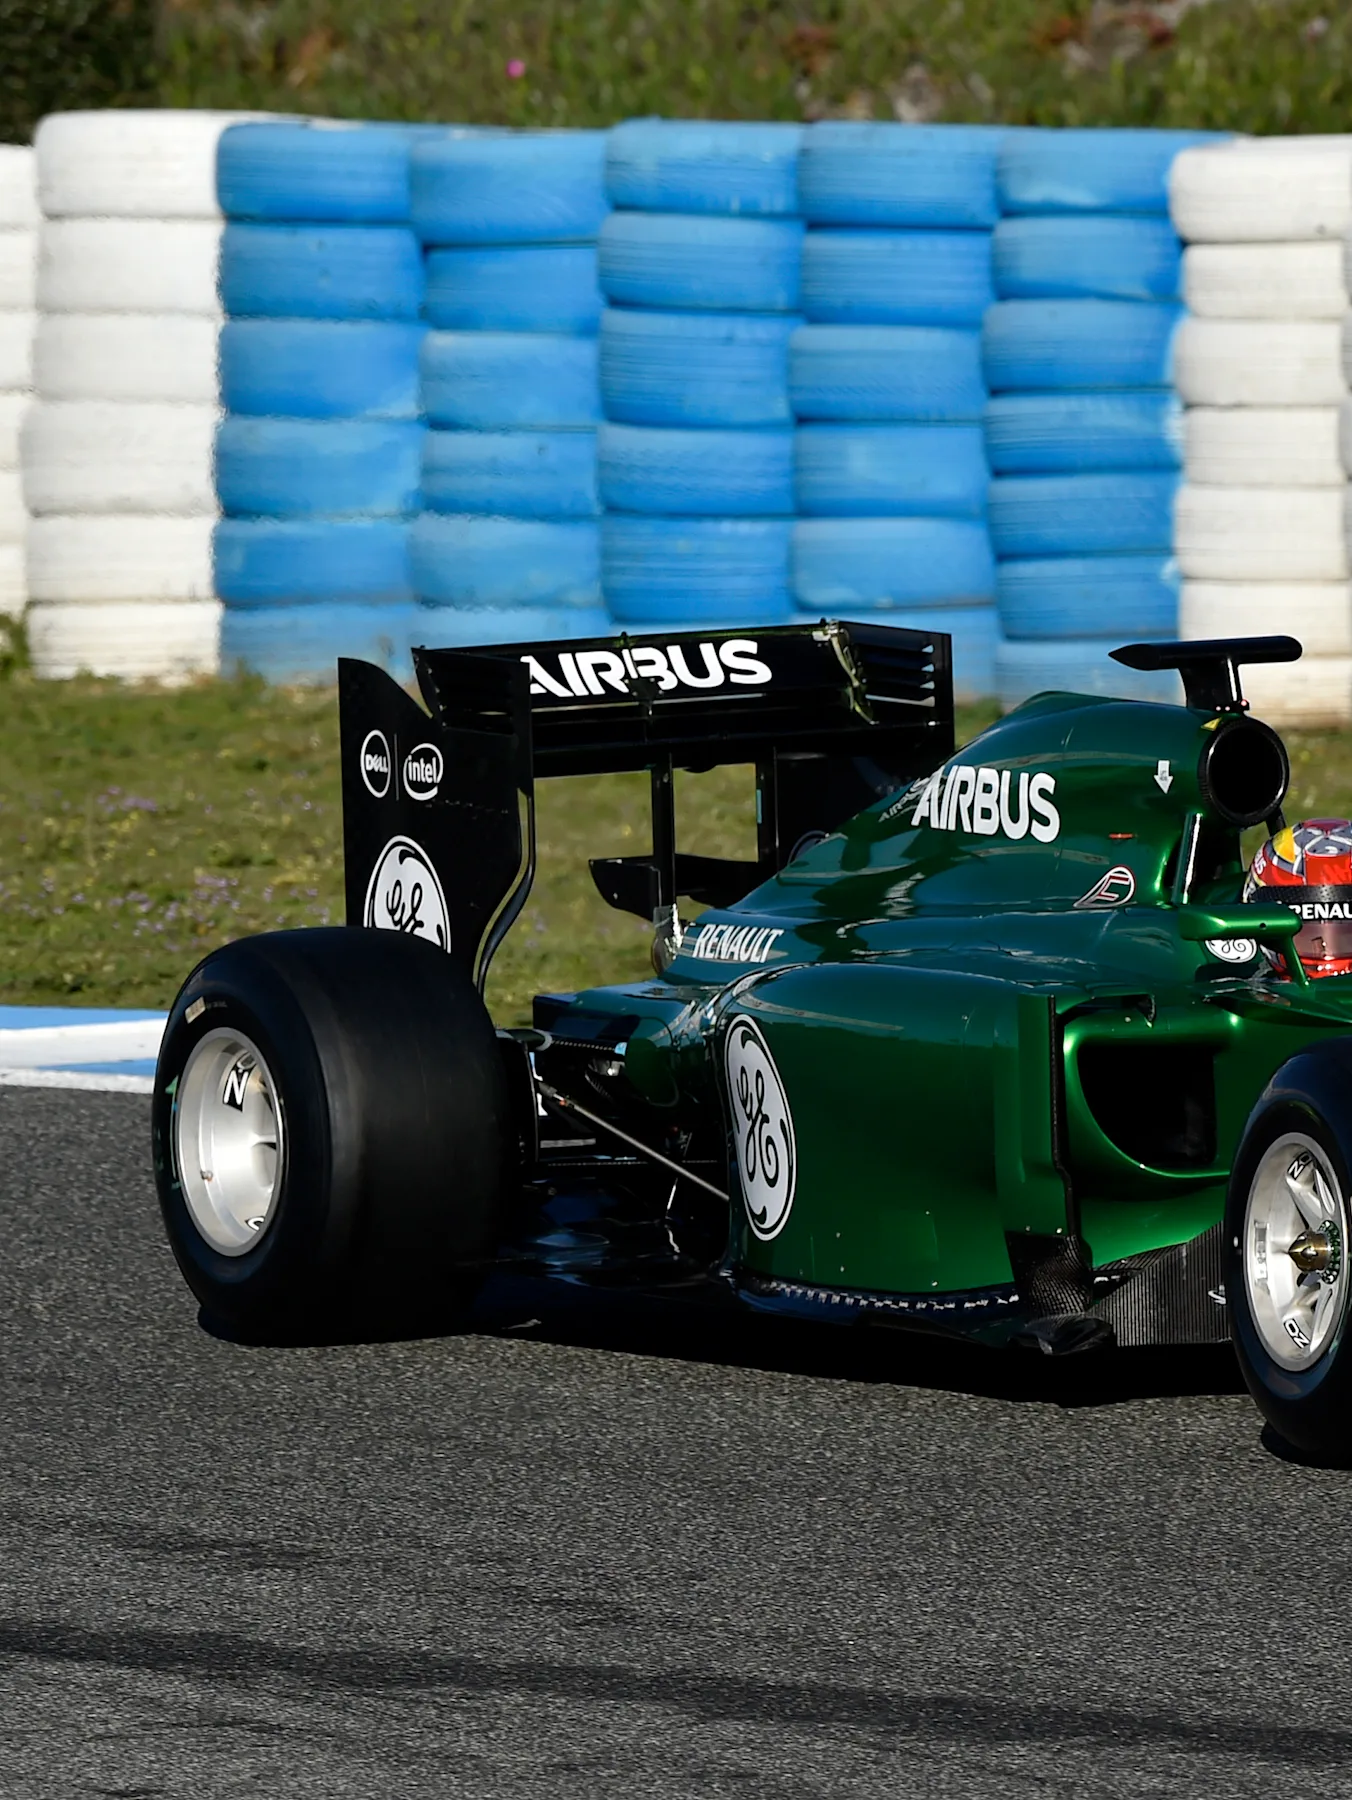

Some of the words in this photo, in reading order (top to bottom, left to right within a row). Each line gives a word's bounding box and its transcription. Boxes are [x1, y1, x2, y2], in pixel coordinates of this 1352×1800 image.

[520, 639, 772, 697] AIRBUS
[365, 753, 388, 773] DELL
[408, 754, 437, 783] intel
[911, 765, 1060, 843] AIRBUS
[692, 924, 785, 963] RENAULT
